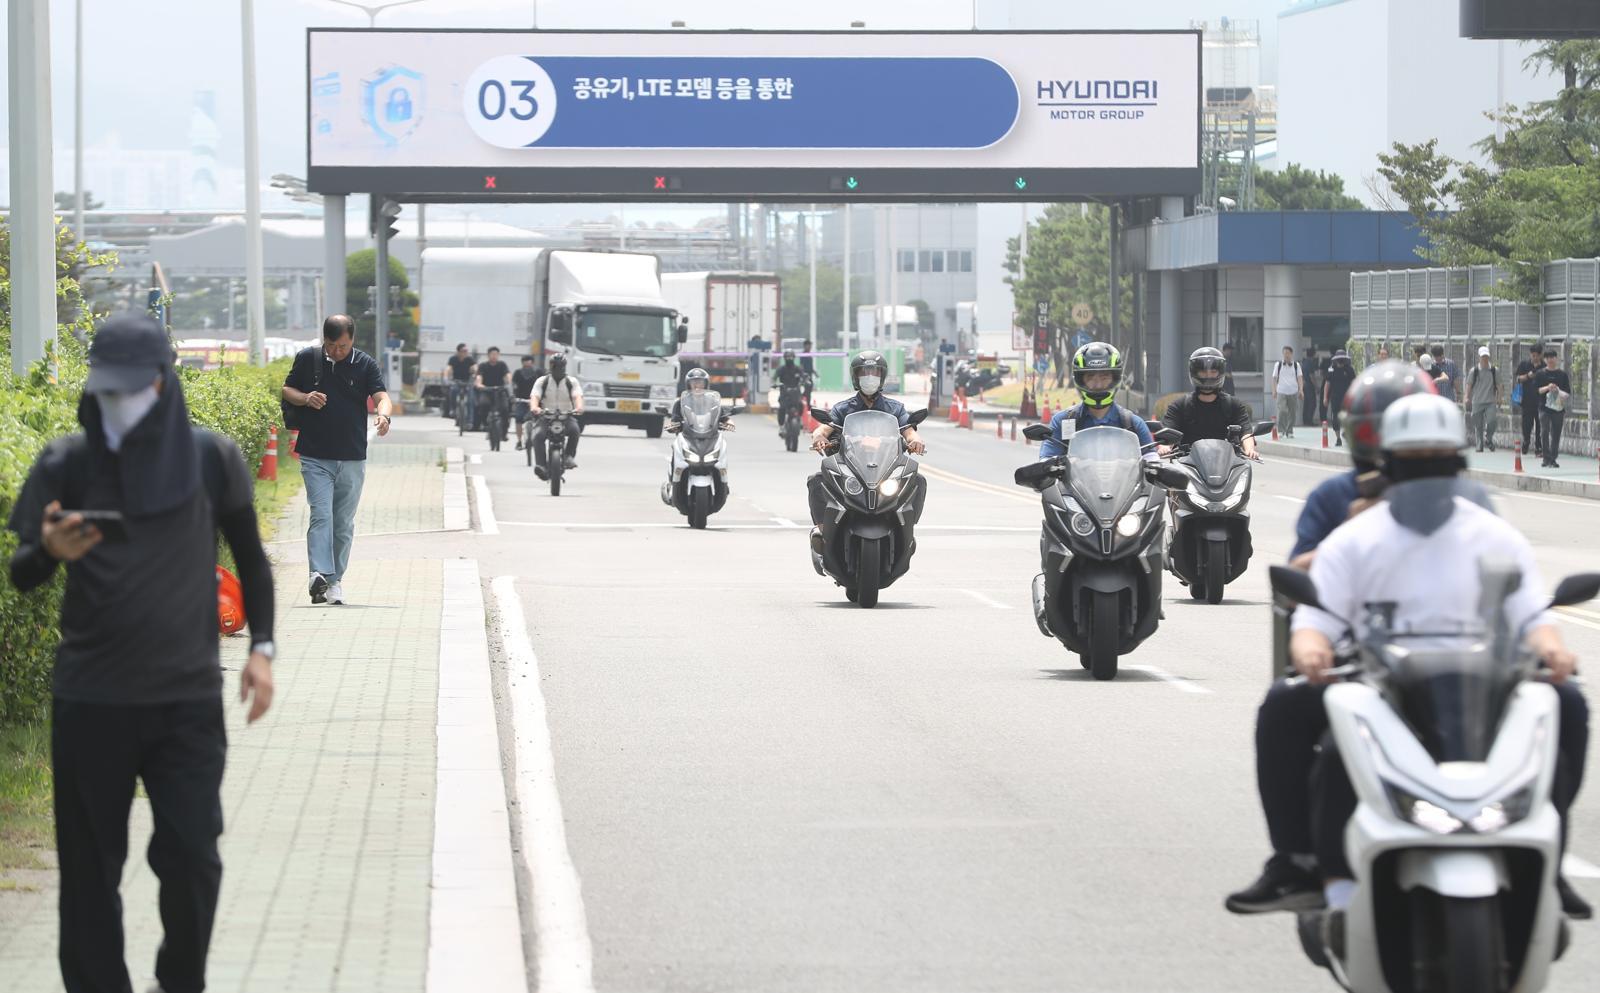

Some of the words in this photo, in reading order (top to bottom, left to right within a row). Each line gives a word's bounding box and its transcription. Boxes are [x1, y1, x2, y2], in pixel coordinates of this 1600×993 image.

[573, 77, 635, 100] 공유기,
[638, 78, 672, 96] LTE
[675, 77, 712, 99] 모뎀
[715, 77, 753, 100] 등을
[756, 77, 794, 99] 통한
[1037, 80, 1158, 99] HYUNDAI
[478, 79, 539, 121] 03
[1050, 110, 1096, 120] MOTOR
[1099, 110, 1144, 120] GROUP
